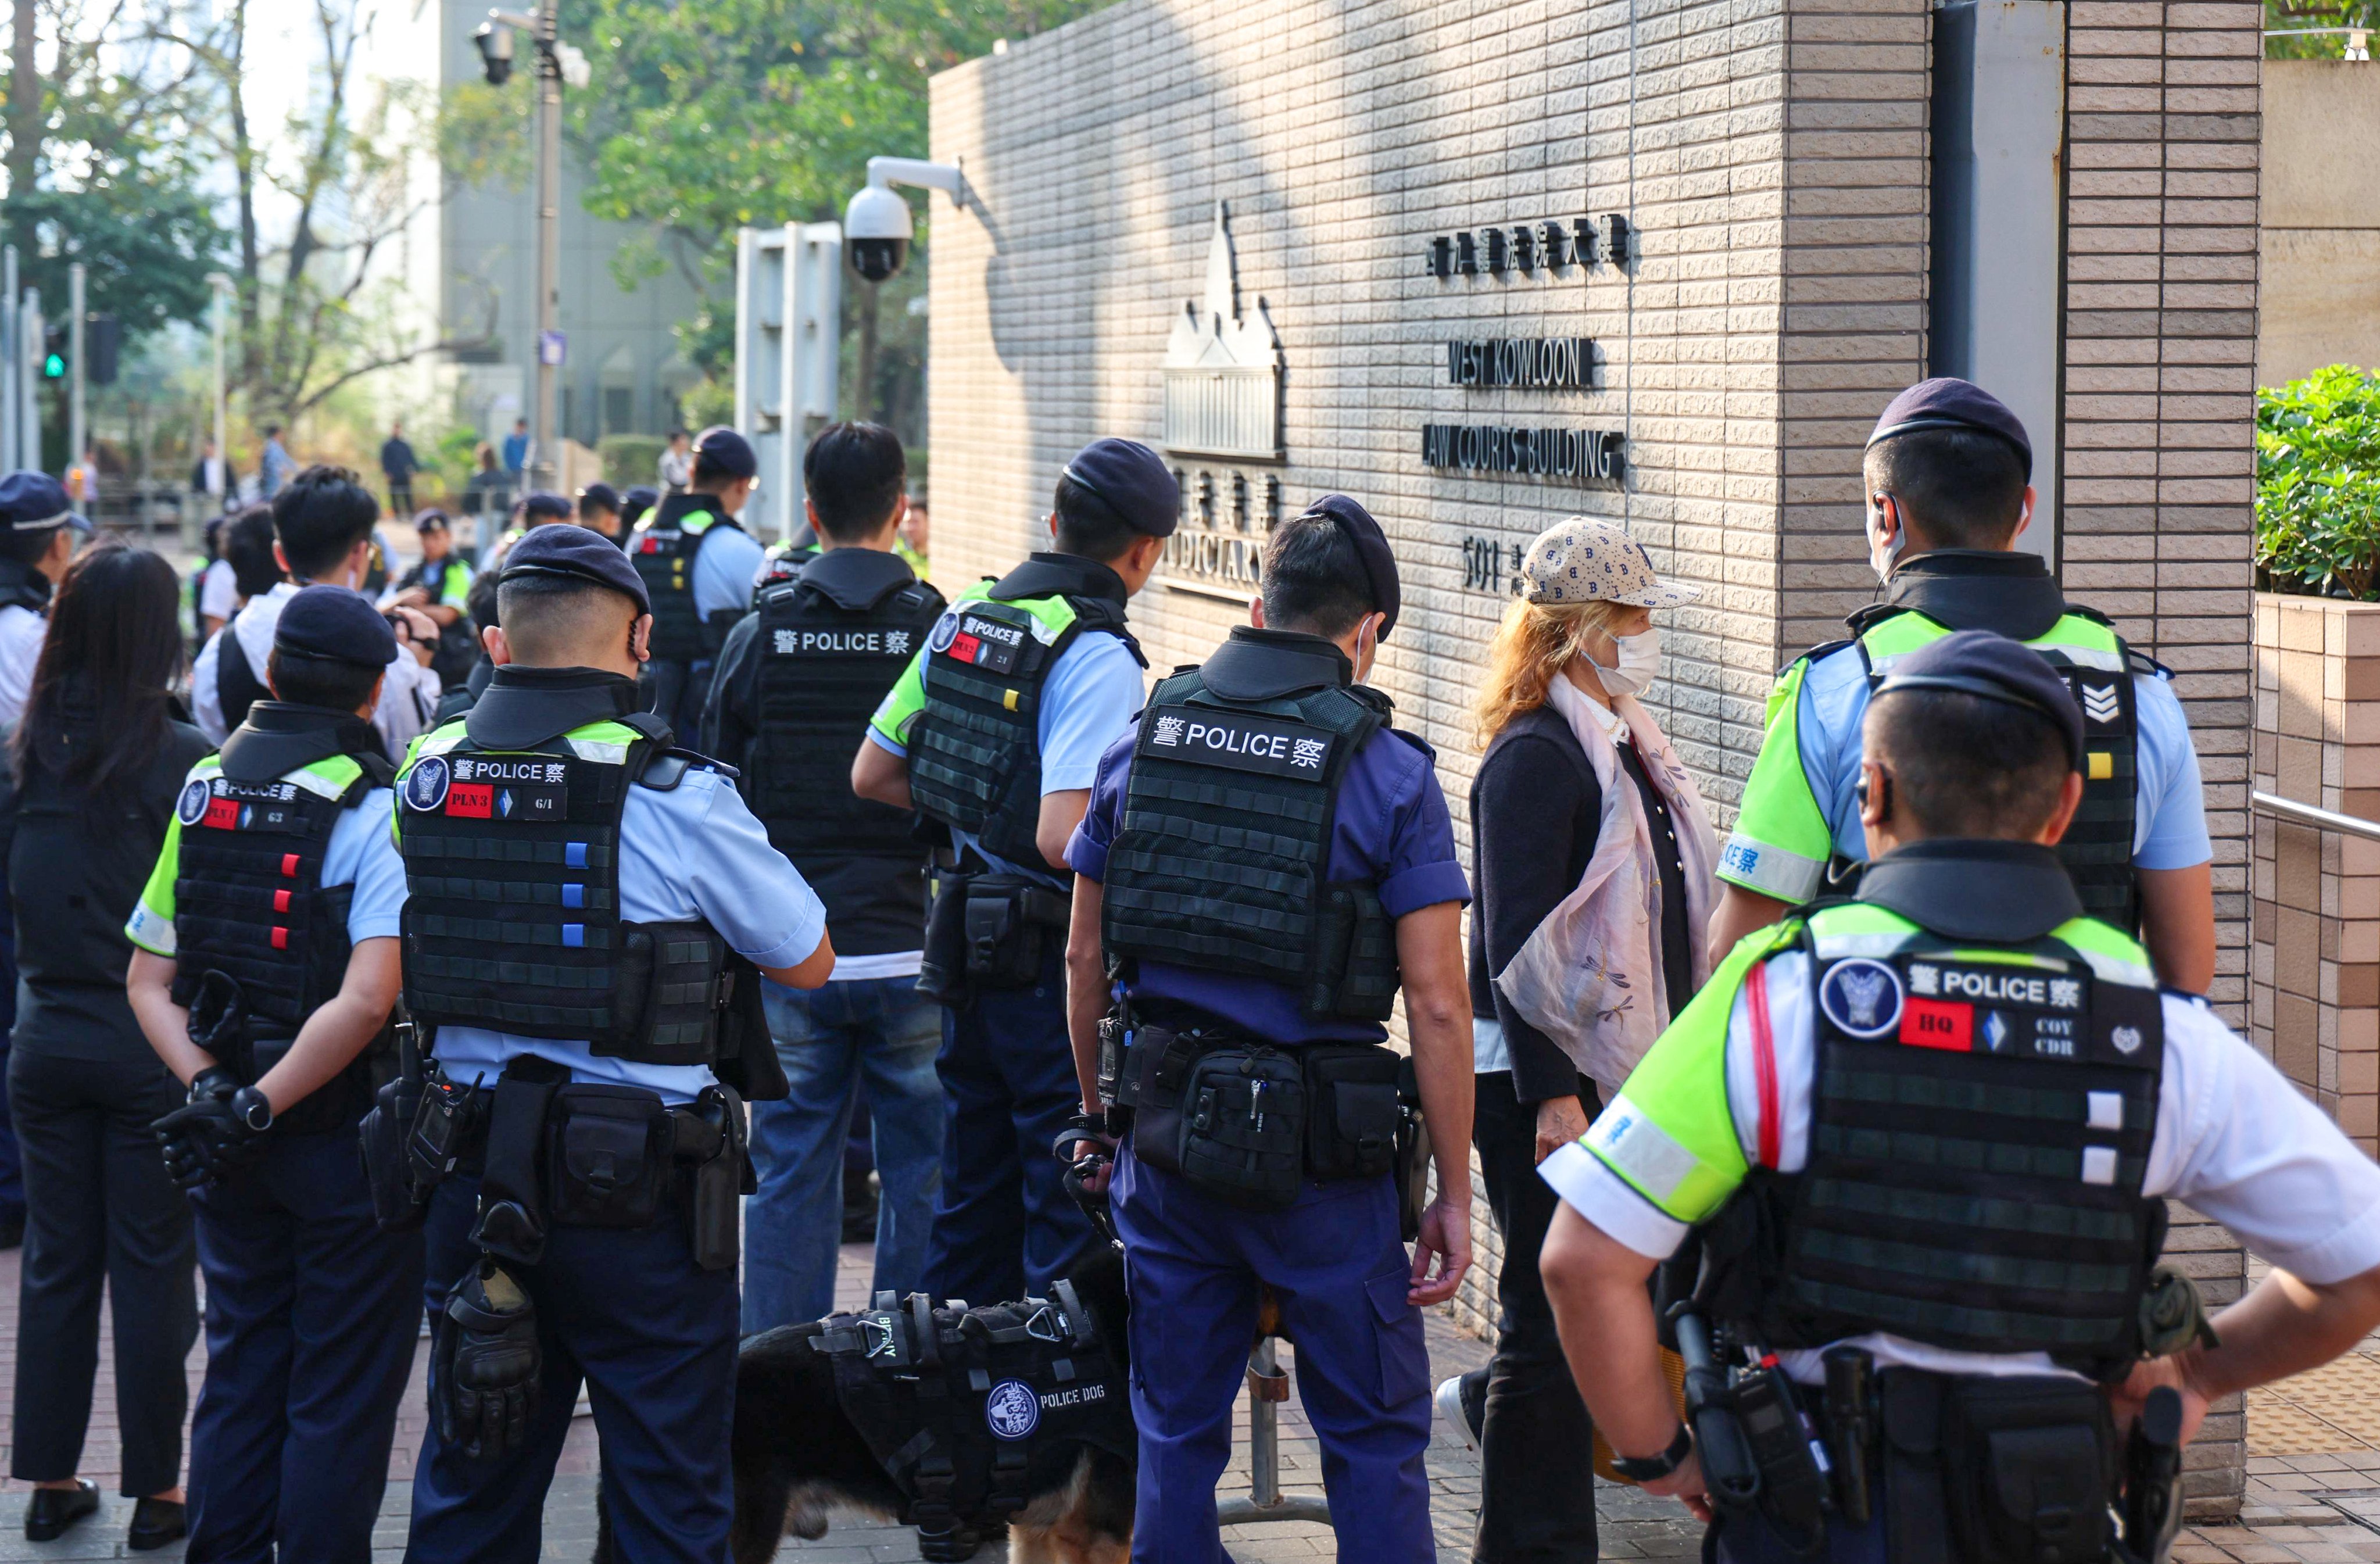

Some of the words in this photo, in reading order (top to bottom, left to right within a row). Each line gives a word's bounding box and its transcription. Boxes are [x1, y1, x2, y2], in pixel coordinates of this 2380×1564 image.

[1494, 338, 1581, 386] KOWLOON
[1458, 426, 1519, 474] COURTS
[1527, 428, 1611, 478] BUILDING
[1164, 529, 1264, 583] UDICIAR
[774, 629, 799, 653] 警
[801, 632, 880, 651] POLICE
[884, 630, 910, 654] 察
[975, 621, 1012, 642] POLICE
[1153, 715, 1186, 747] 警
[1185, 723, 1289, 759] POLICE
[1290, 738, 1326, 770] 察
[454, 758, 475, 780] 警
[476, 763, 542, 779] POLICE
[545, 763, 566, 783] 察
[452, 793, 478, 806] PLN
[480, 795, 488, 807] 3
[1737, 849, 1758, 874] 察
[1944, 971, 2045, 1004] POLICE
[2049, 979, 2080, 1008] 察
[1920, 1013, 1953, 1034] HQ
[2035, 1018, 2073, 1036] COY
[2035, 1038, 2074, 1056] CDR
[1040, 1390, 1079, 1409] POLICE
[1082, 1384, 1105, 1401] DOG
